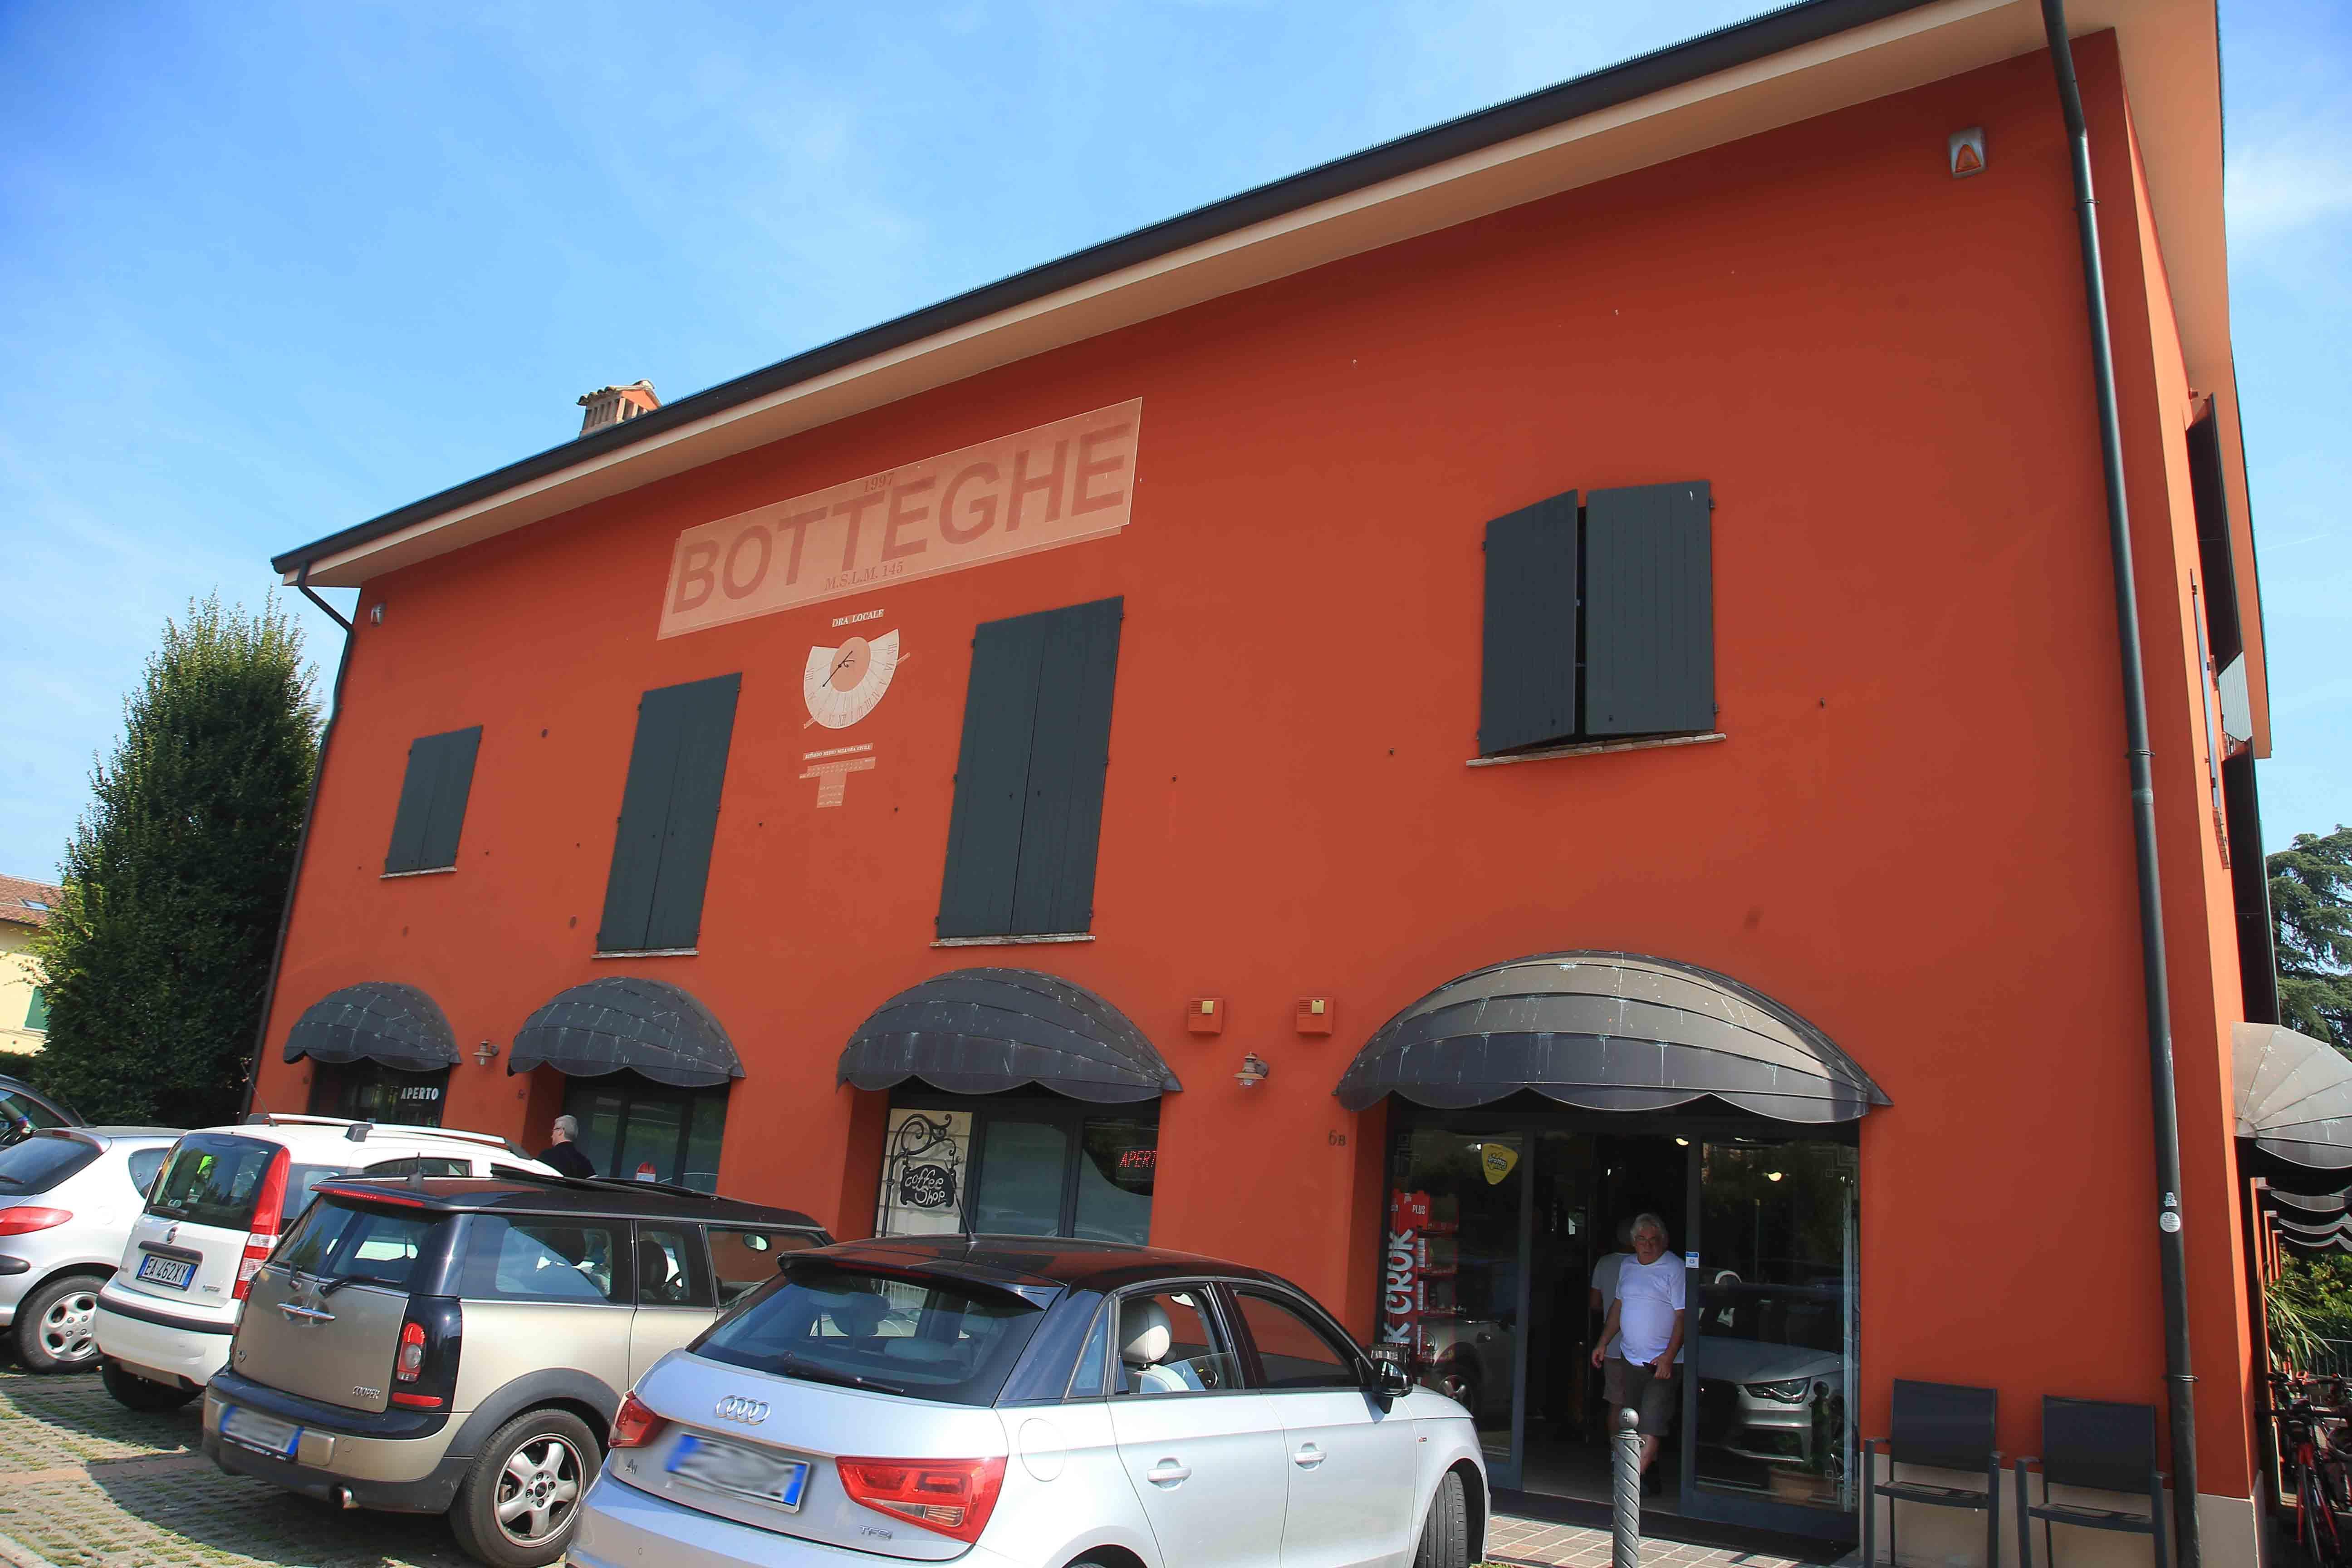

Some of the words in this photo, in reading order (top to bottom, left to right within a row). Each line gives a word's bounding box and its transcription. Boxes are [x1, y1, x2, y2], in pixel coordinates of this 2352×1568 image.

[864, 472, 894, 492] 1997
[672, 423, 1131, 614] BOTTEGHE
[882, 562, 903, 577] 145
[853, 609, 884, 623] LOCALE
[400, 1087, 439, 1100] APERTO
[915, 1185, 945, 1205] Shop
[1412, 1205, 1426, 1215] PLUS
[144, 1258, 158, 1276] EA
[157, 1261, 189, 1282] 462XY
[1385, 1228, 1414, 1314] CROK
[352, 1386, 381, 1399] COOPER
